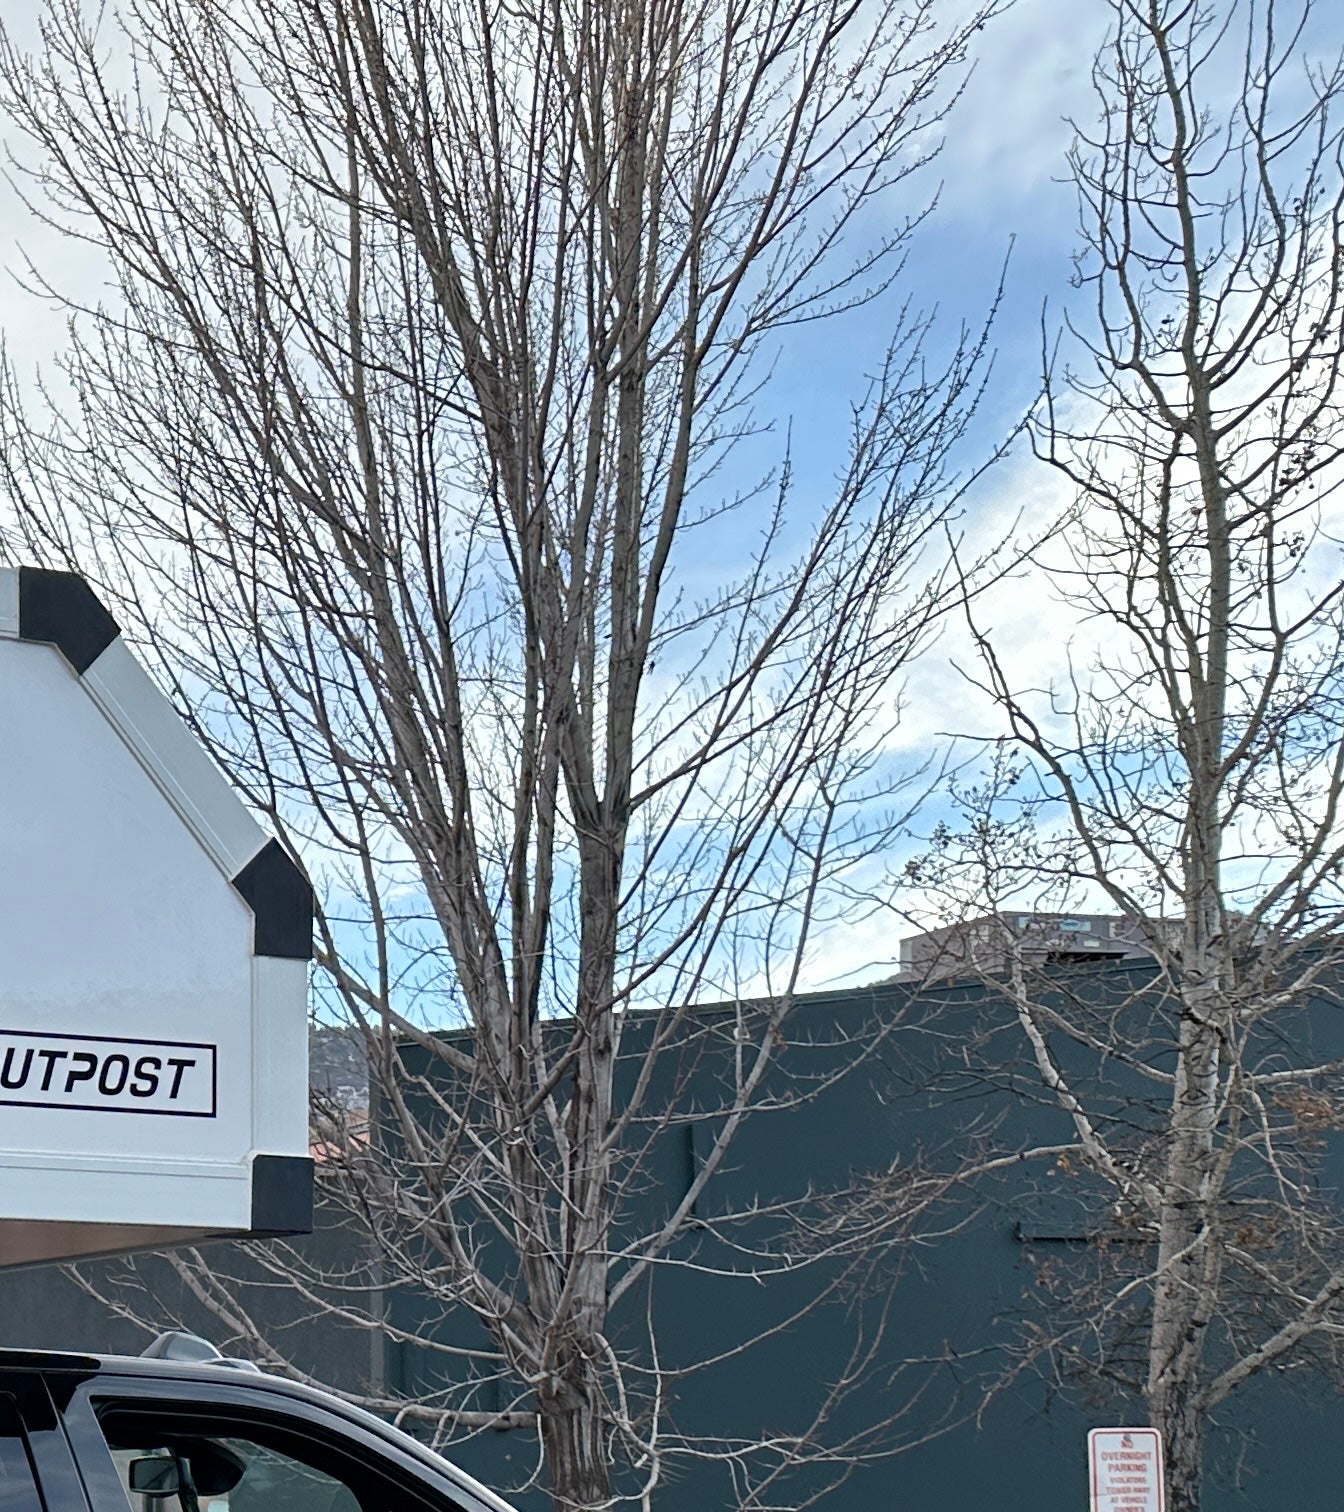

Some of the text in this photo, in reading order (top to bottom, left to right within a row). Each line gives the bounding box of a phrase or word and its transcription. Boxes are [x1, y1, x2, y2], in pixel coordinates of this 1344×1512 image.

[1121, 1440, 1134, 1449] NO
[1101, 1451, 1152, 1461] OVERNIGHT
[1108, 1463, 1148, 1473] PARKING
